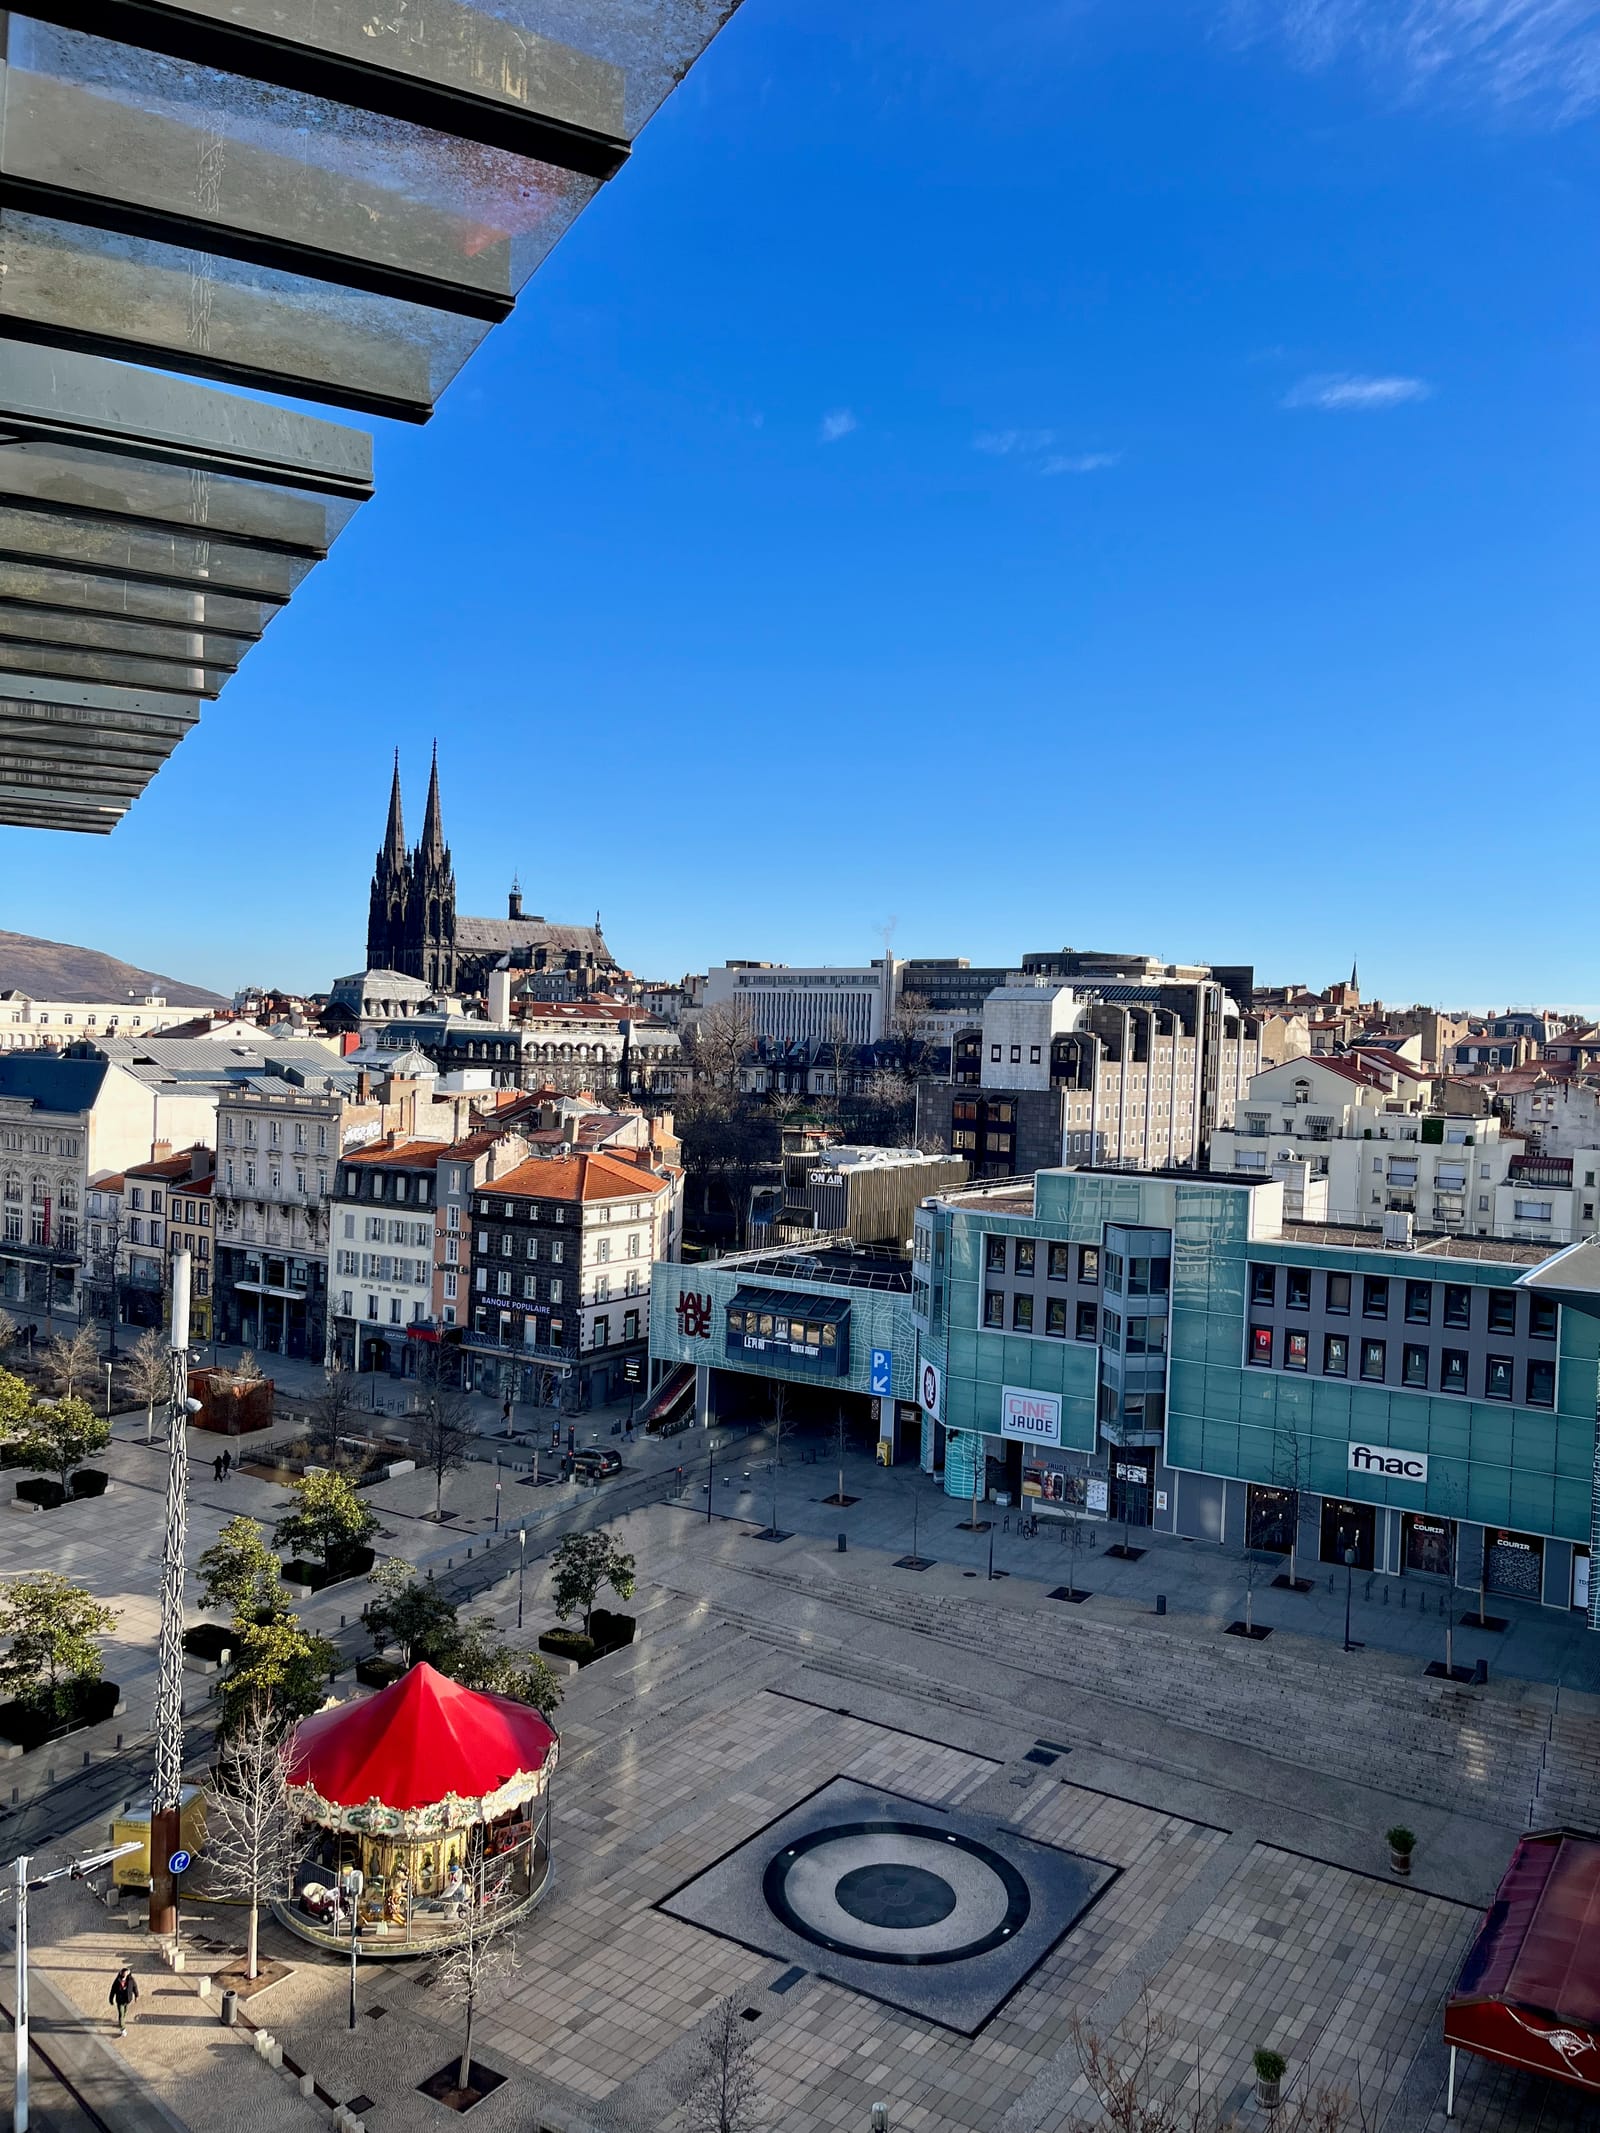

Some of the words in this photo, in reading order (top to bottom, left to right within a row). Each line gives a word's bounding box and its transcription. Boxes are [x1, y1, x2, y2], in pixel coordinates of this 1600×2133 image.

[810, 1172, 825, 1183] ON
[826, 1174, 843, 1185] AIR
[481, 1296, 511, 1308] BANQUE
[511, 1301, 551, 1314] POPULAIRE
[1009, 1398, 1054, 1421] CINE
[1008, 1415, 1054, 1433] JAUDE
[1047, 1462, 1068, 1472] JAUDE
[1351, 1445, 1424, 1478] fnac
[1413, 1523, 1445, 1536] COURIR
[1496, 1538, 1531, 1551] COURIR
